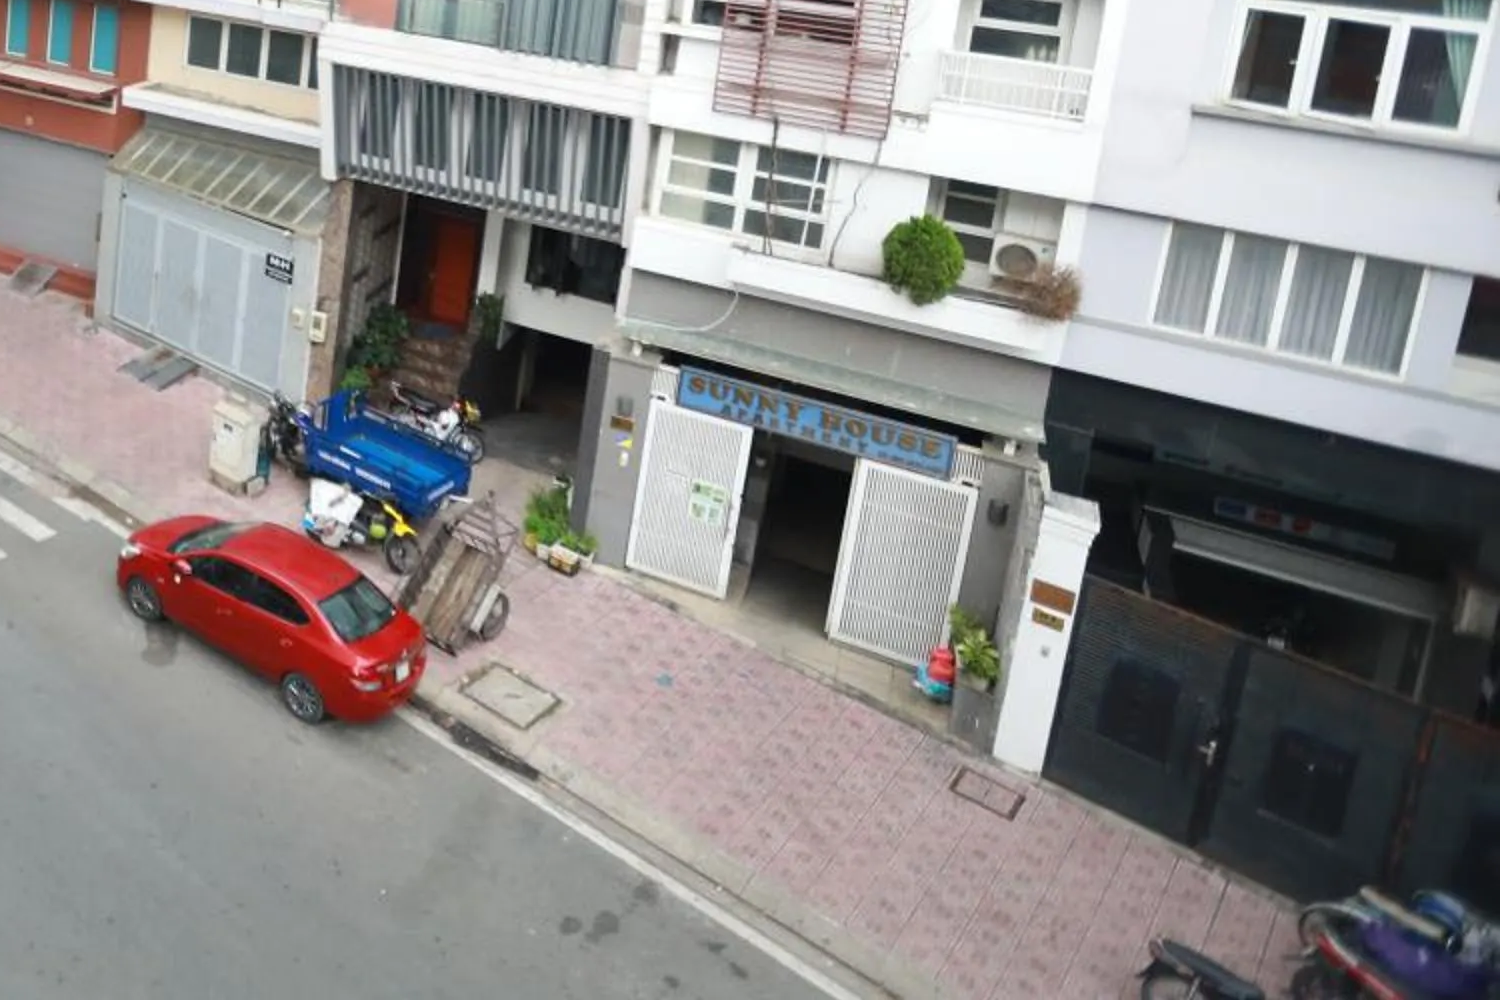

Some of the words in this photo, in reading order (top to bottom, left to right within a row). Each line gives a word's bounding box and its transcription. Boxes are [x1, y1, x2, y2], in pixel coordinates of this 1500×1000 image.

[689, 374, 805, 423] SUNNY
[819, 407, 943, 460] HOUSE
[719, 403, 869, 454] APARTMENT
